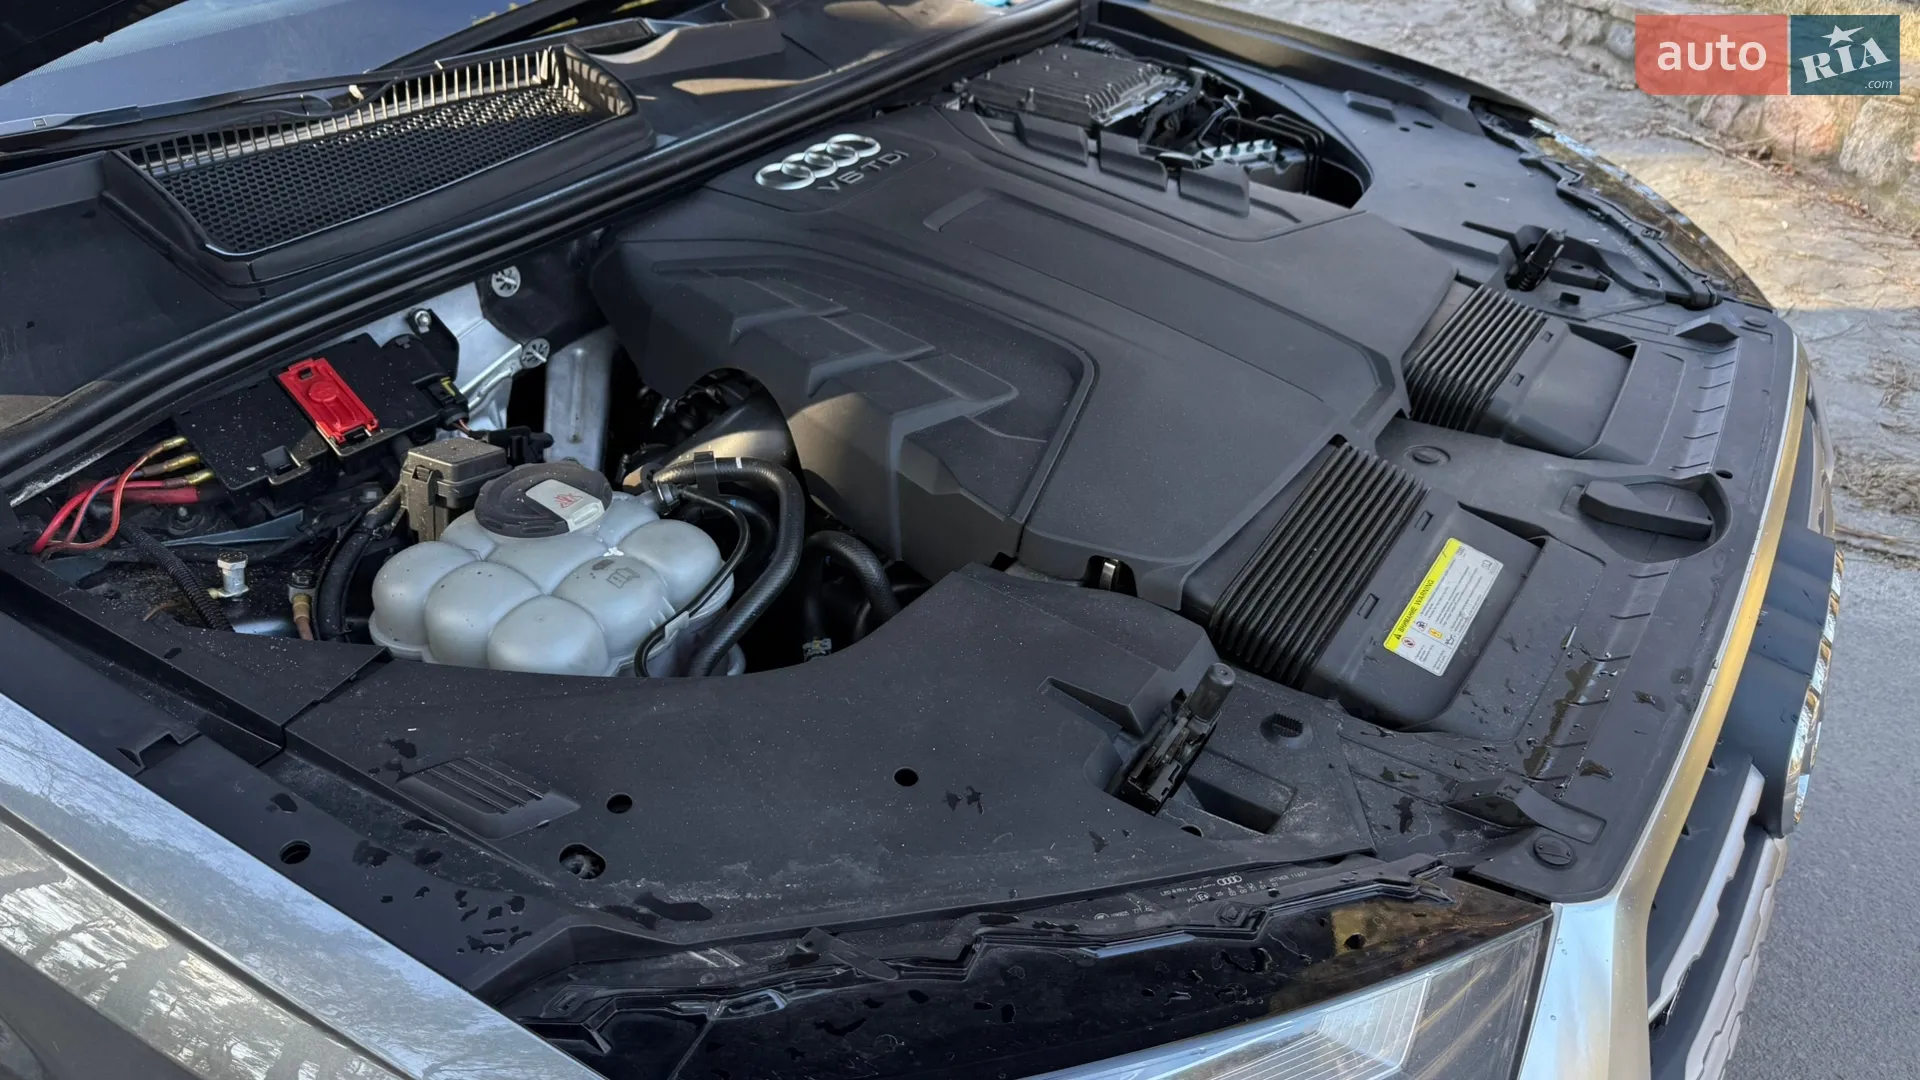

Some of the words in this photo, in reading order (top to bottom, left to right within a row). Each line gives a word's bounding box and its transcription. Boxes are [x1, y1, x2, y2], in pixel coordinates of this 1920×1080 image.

[817, 170, 865, 191] V6
[860, 150, 909, 171] TDI
[1398, 606, 1417, 633] ВНИМАНИЕ
[1414, 579, 1435, 606] WARNING
